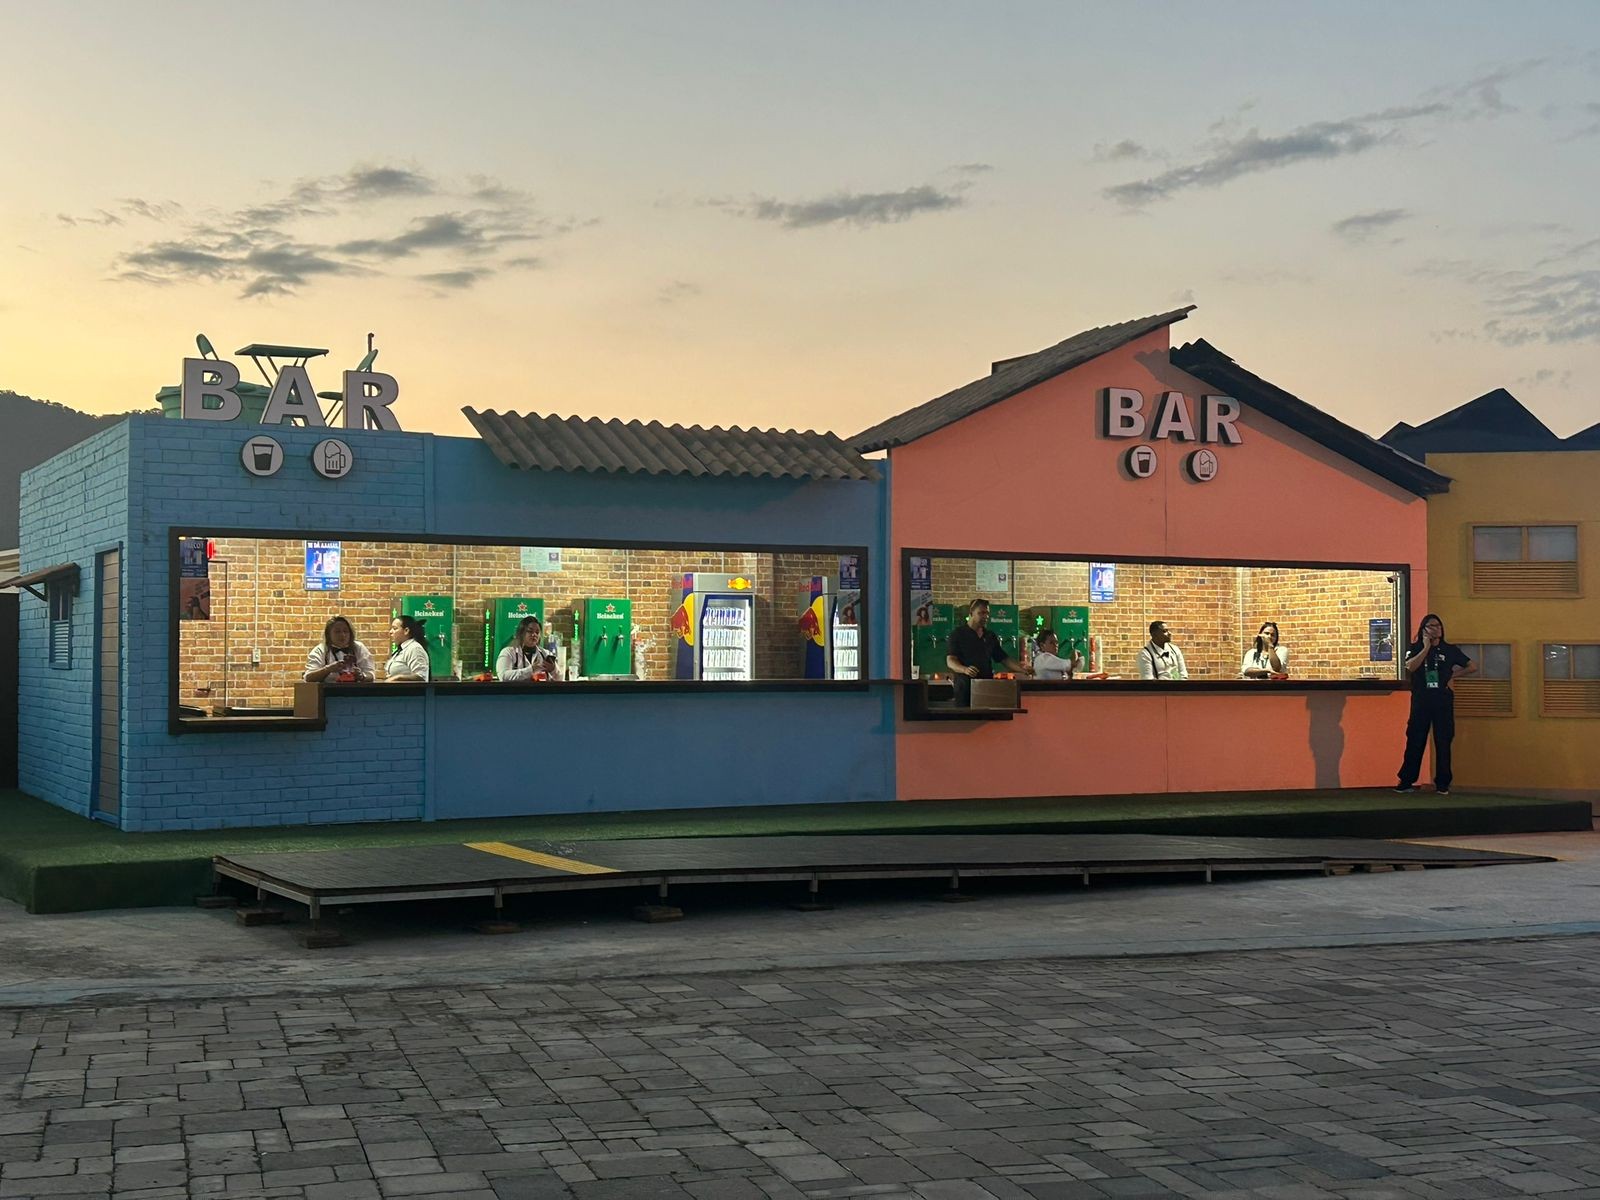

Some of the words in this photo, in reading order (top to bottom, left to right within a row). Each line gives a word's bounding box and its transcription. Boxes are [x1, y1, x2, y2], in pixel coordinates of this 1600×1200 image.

[181, 357, 402, 432] BAR
[1103, 387, 1243, 444] BAR
[596, 612, 624, 620] Heineken
